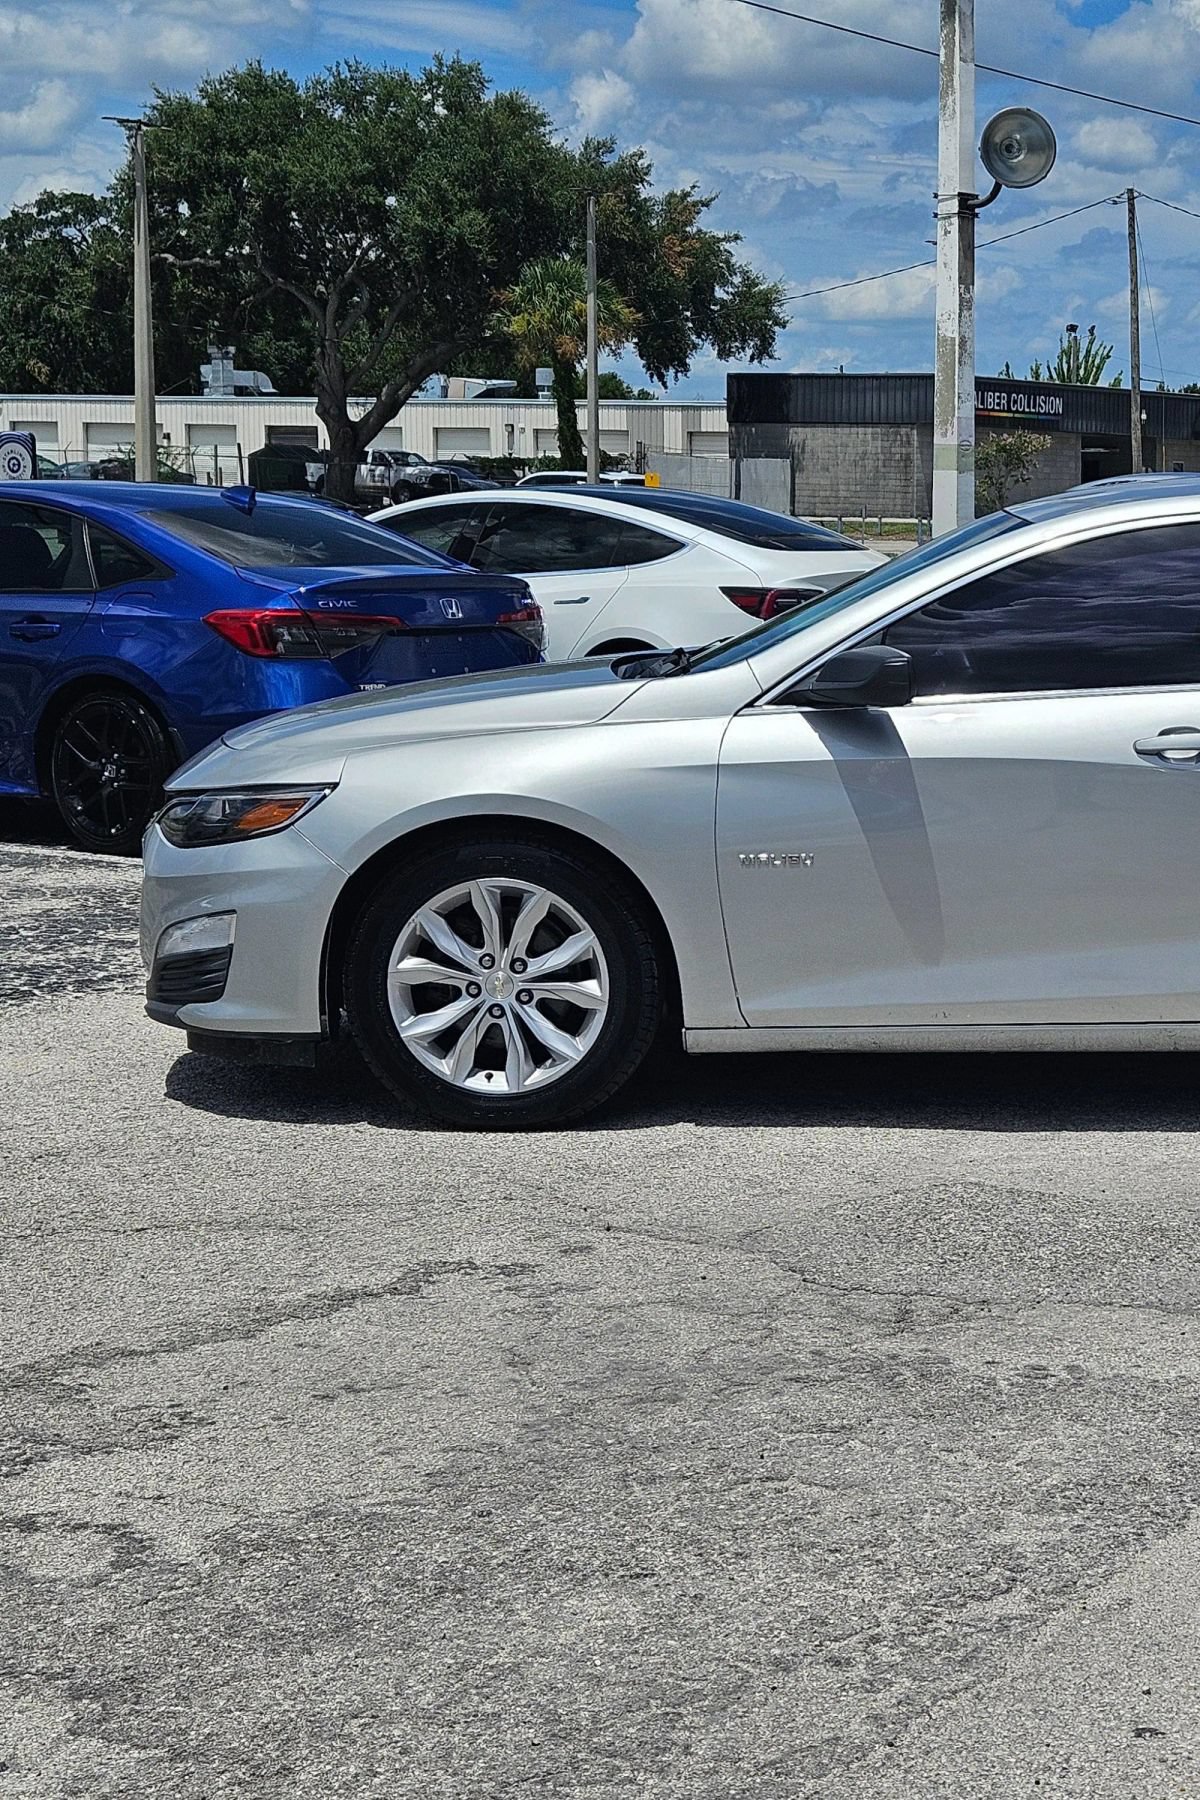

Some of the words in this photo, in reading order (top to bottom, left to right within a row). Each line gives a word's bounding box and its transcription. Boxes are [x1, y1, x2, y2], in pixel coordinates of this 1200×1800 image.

[1010, 393, 1063, 414] COLLISION
[318, 600, 359, 608] CIVIC
[738, 853, 815, 867] MALIBU
